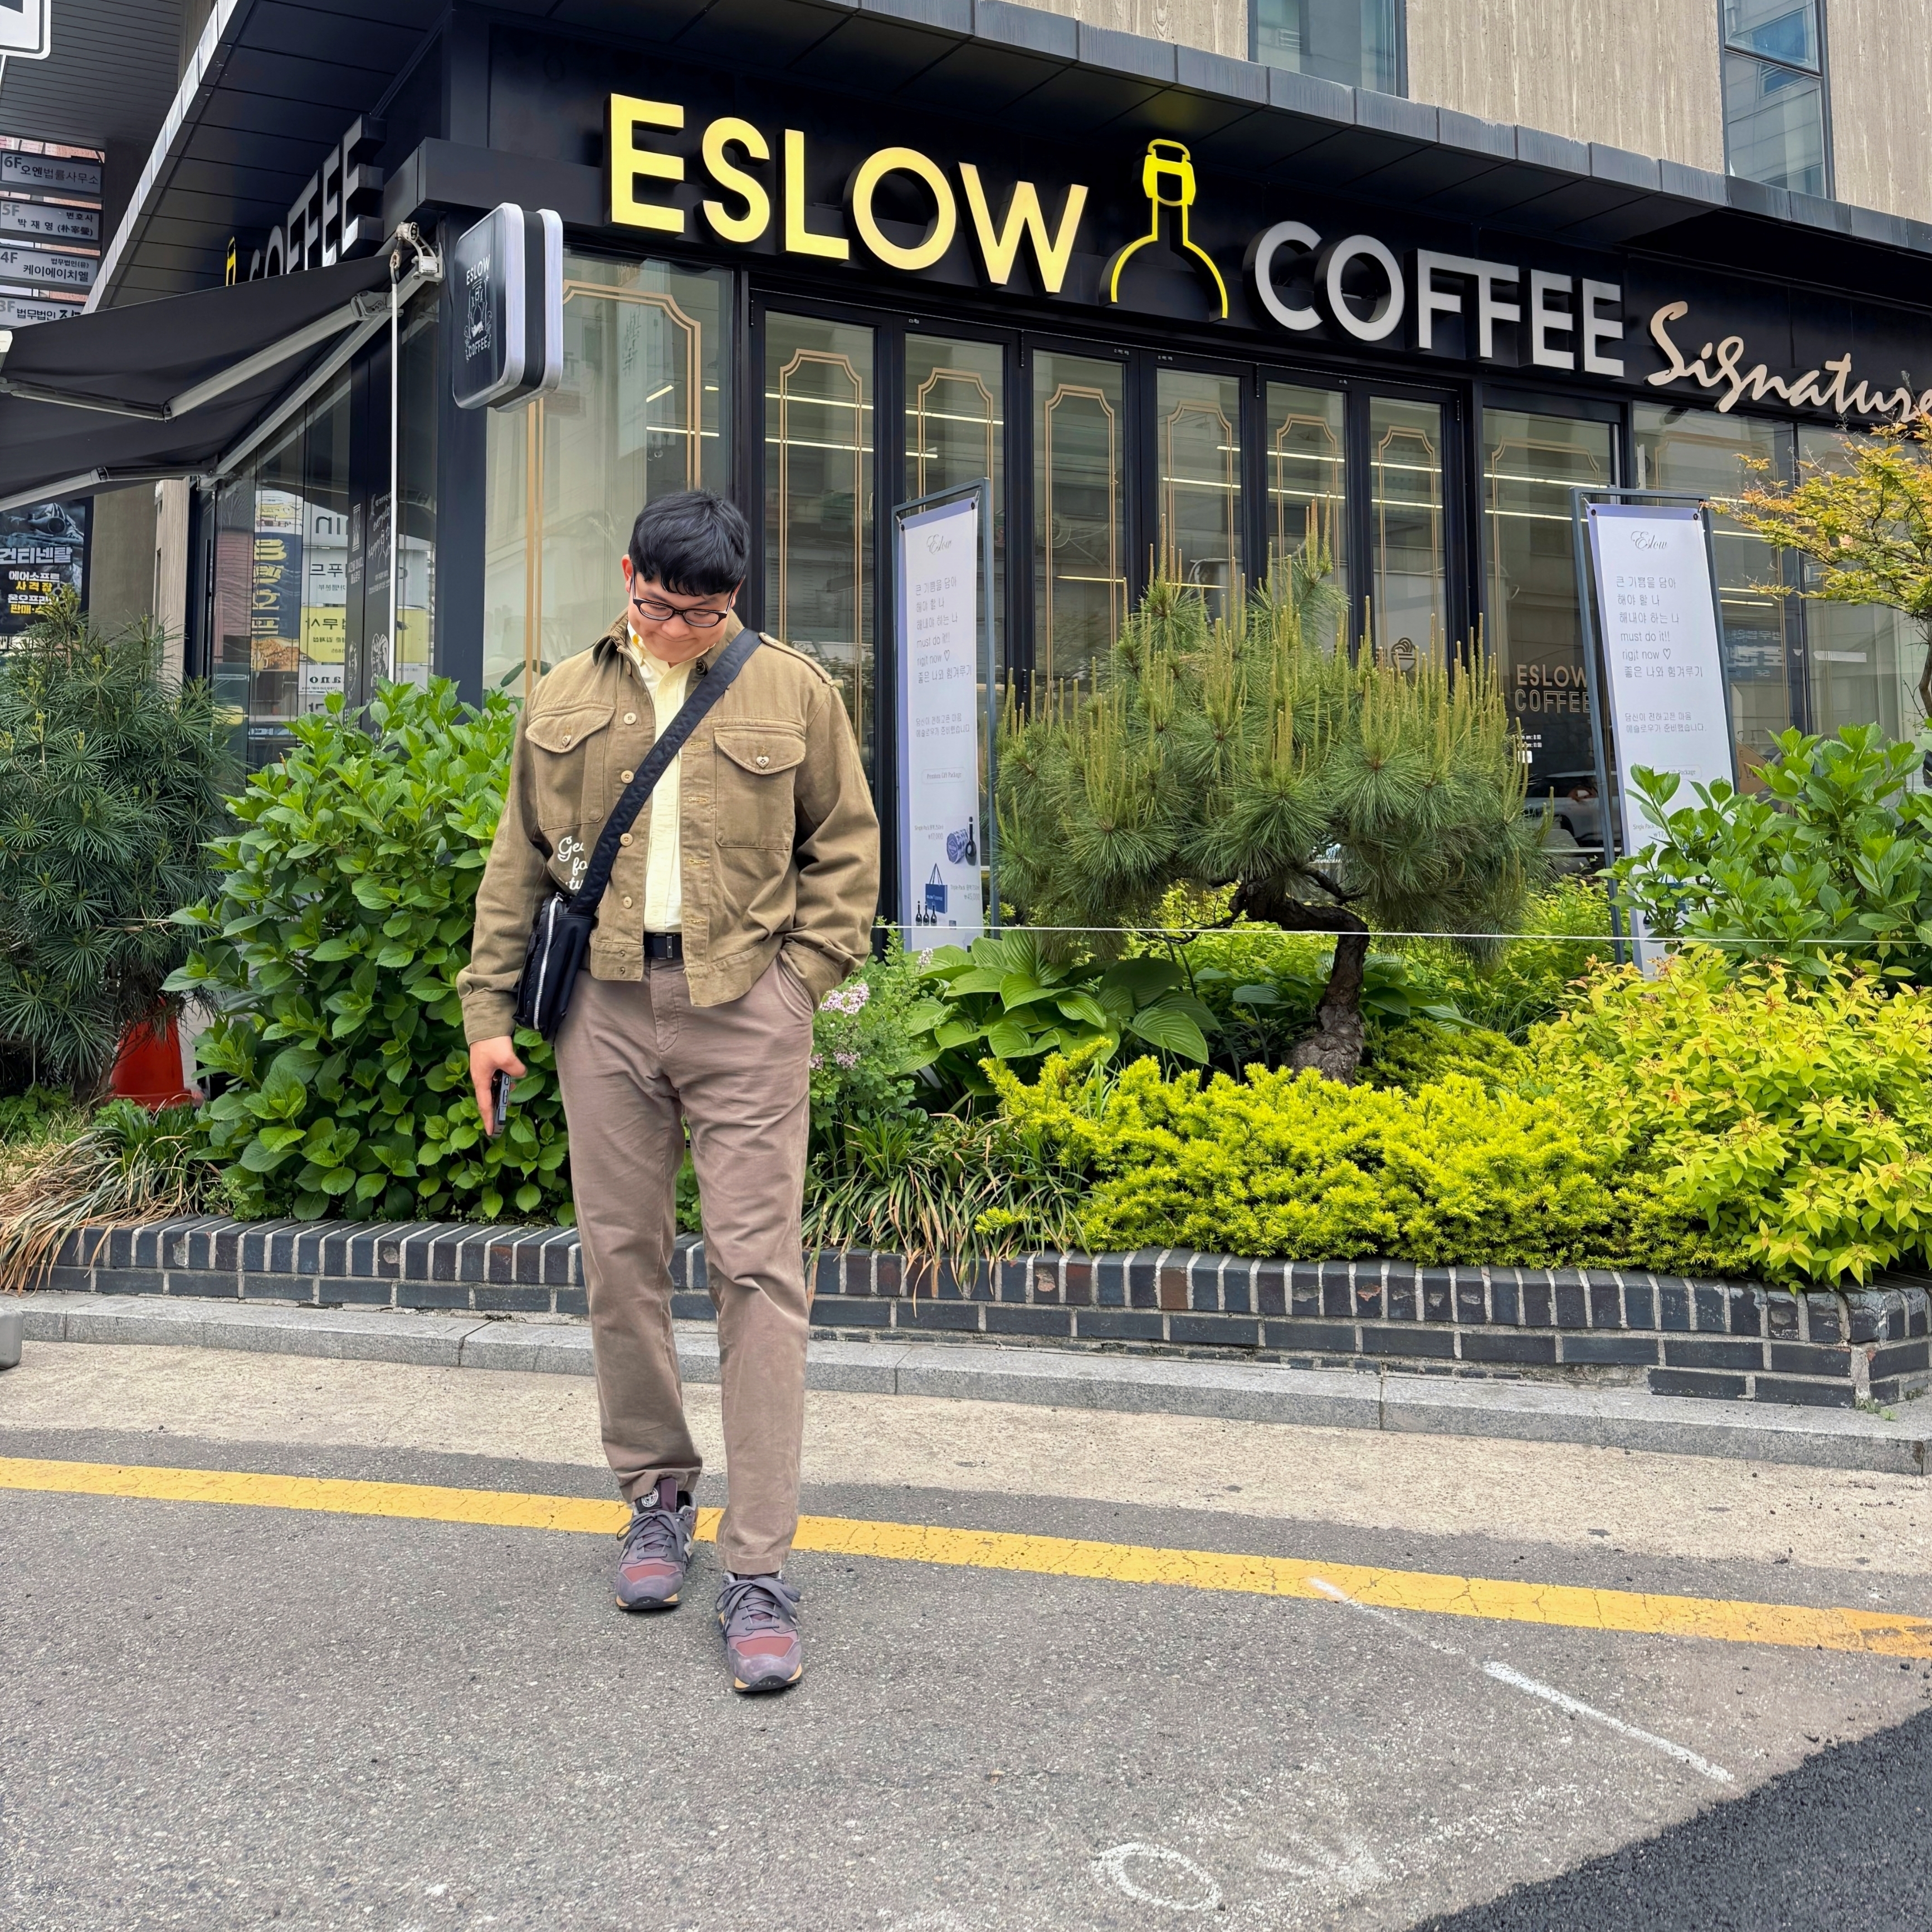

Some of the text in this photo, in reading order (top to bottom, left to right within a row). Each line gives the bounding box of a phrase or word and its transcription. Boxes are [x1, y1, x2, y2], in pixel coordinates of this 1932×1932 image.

[4, 156, 22, 168] 6F
[610, 92, 1089, 294] ESLOW
[2, 204, 19, 216] 5F
[0, 251, 18, 264] 4F
[23, 264, 89, 282] 케이에이치엘
[466, 253, 490, 286] ESLOW
[1248, 221, 1625, 378] COFFEE
[17, 308, 56, 321] 법무법인
[467, 334, 489, 359] COFFEE
[1631, 530, 1667, 552] Eslow
[8, 570, 60, 583] 에어소프트
[1617, 576, 1676, 589] 큰 기쁨을 담아
[16, 580, 53, 593] 사격장
[8, 593, 60, 606] 온오프라
[1617, 594, 1636, 606] 해야
[1651, 594, 1660, 606] 나
[1619, 612, 1679, 625] 해내야 하는 나
[933, 636, 940, 646] do
[1620, 630, 1671, 642] must do it!!
[1641, 650, 1660, 660] now
[1516, 663, 1588, 688] ESLOW
[1646, 666, 1664, 677] 나와
[1668, 666, 1703, 678] 힘겨루기
[1515, 689, 1592, 714] COFFEE
